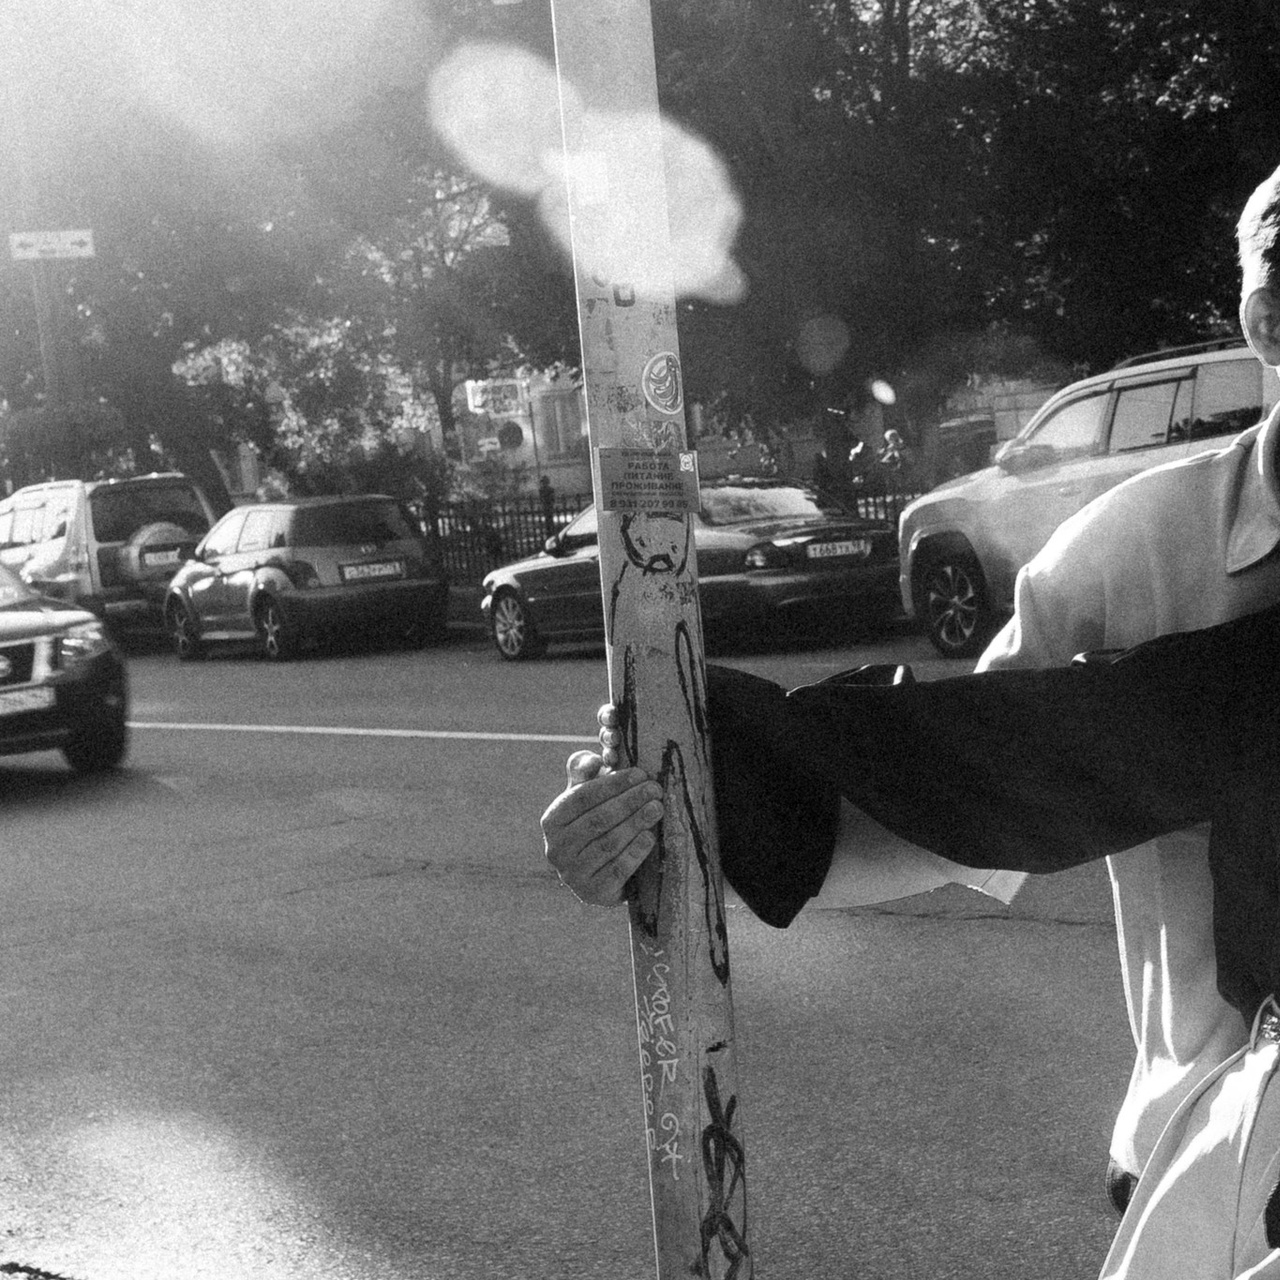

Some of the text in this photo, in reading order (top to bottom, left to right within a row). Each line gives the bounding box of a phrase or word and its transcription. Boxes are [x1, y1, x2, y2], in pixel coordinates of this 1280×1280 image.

[627, 462, 670, 471] РАБОТА
[623, 472, 674, 481] ПИТАНИЕ
[611, 482, 684, 491] ПРОЖИВАНИЕ
[610, 499, 617, 508] 8
[639, 499, 660, 508] 207
